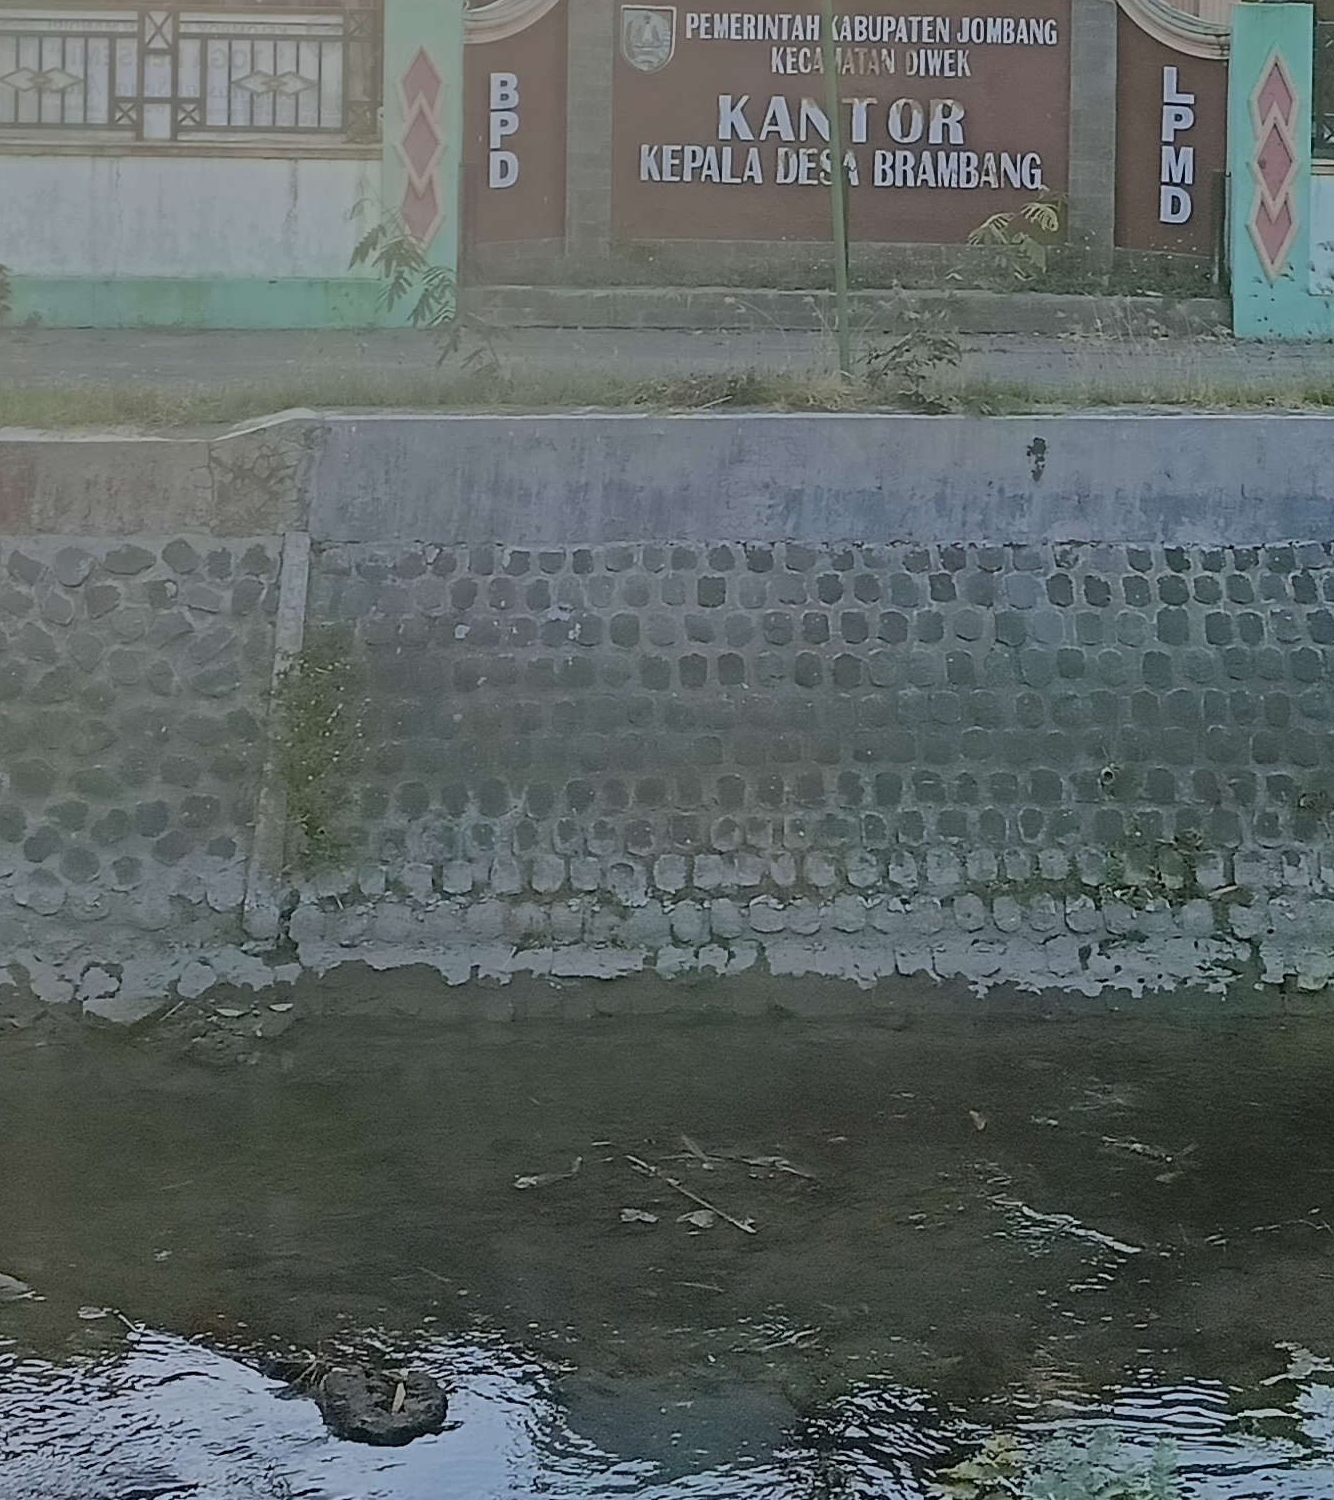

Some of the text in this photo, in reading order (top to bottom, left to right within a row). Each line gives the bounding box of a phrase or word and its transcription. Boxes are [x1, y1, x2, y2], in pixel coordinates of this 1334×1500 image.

[685, 12, 1058, 46] PEMERINTAH KABUPATEN JOMBANG
[905, 47, 972, 78] DIWEK
[488, 72, 520, 190] BPD
[717, 94, 965, 144] KANTOR
[639, 144, 1045, 191] KEPALA DESA BRAMBANG
[1158, 66, 1195, 226] LPMD
